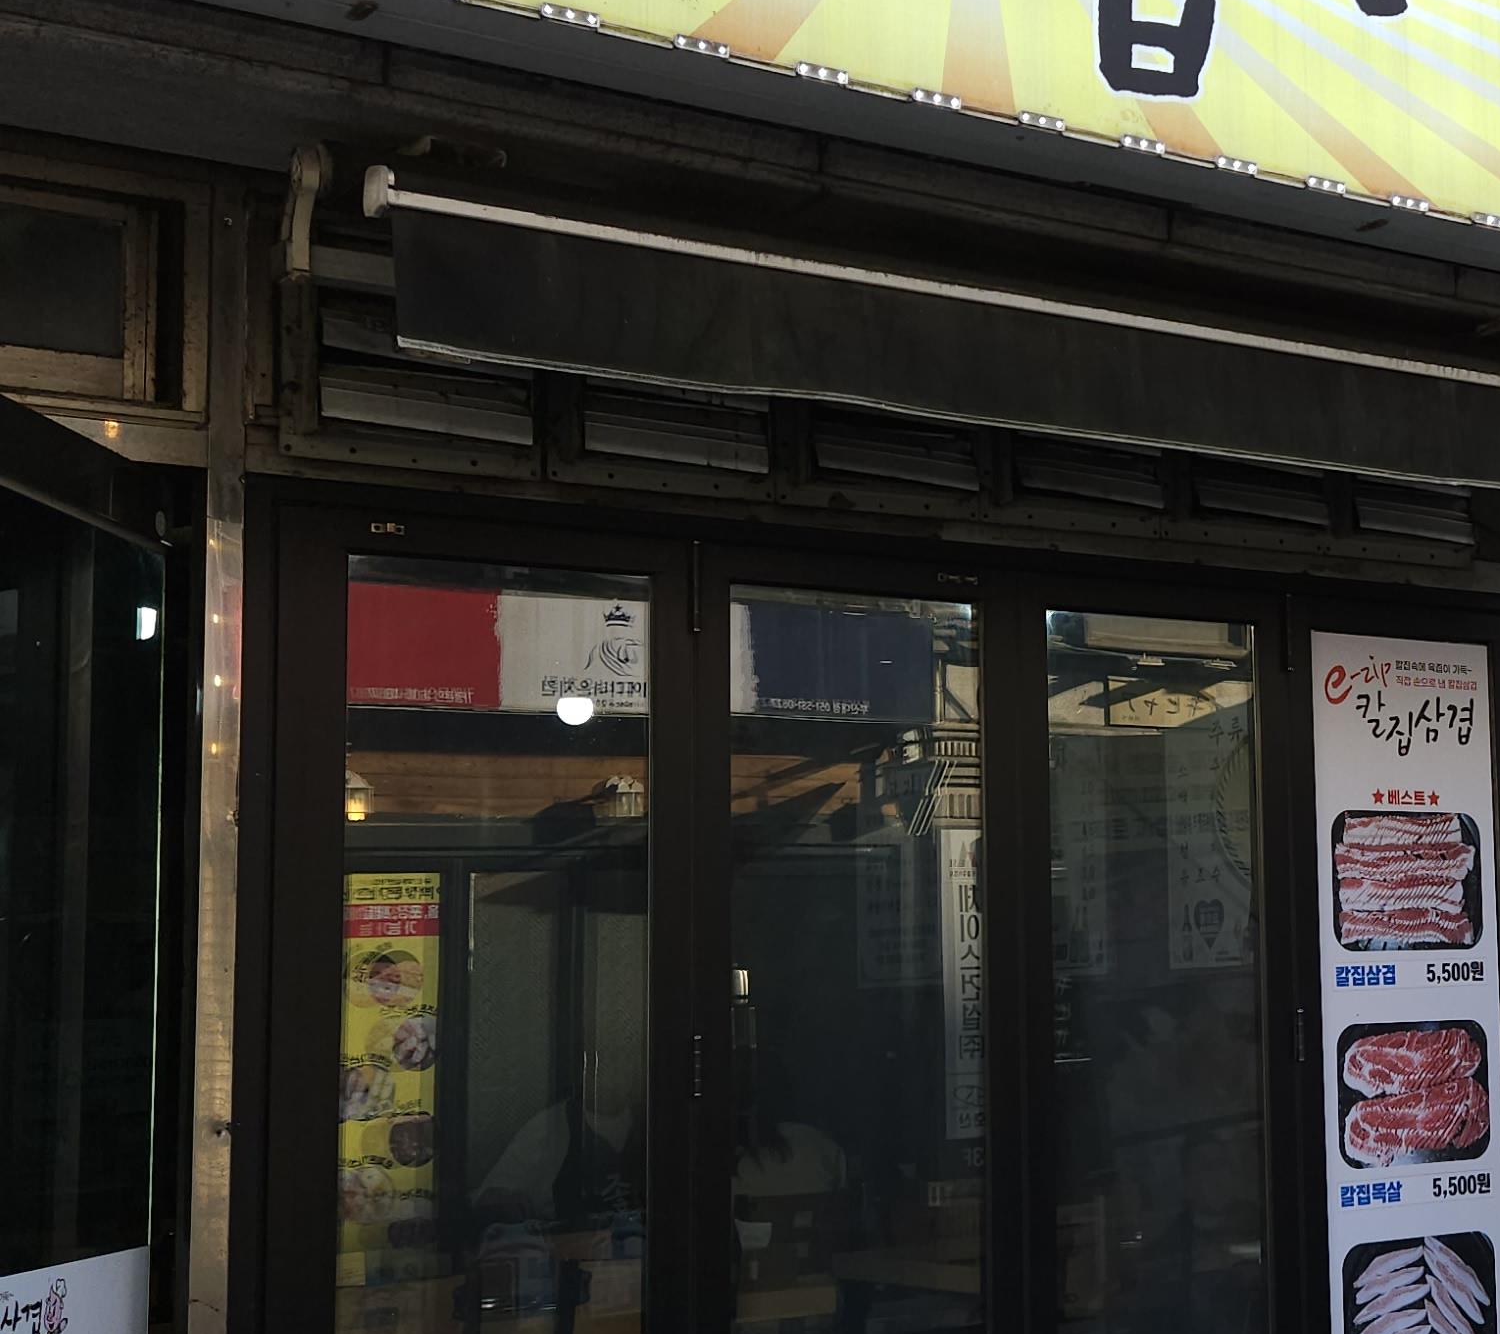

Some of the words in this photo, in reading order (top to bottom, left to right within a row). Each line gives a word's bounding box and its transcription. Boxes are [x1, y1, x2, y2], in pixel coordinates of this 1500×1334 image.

[1356, 691, 1475, 757] 칼집삼겹
[1387, 788, 1426, 807] 베스트
[1335, 964, 1397, 988] 칼집삼겹
[1426, 961, 1485, 984] 5,500원
[1340, 1180, 1402, 1208] 칼집목살
[1432, 1172, 1492, 1198] 5,500원
